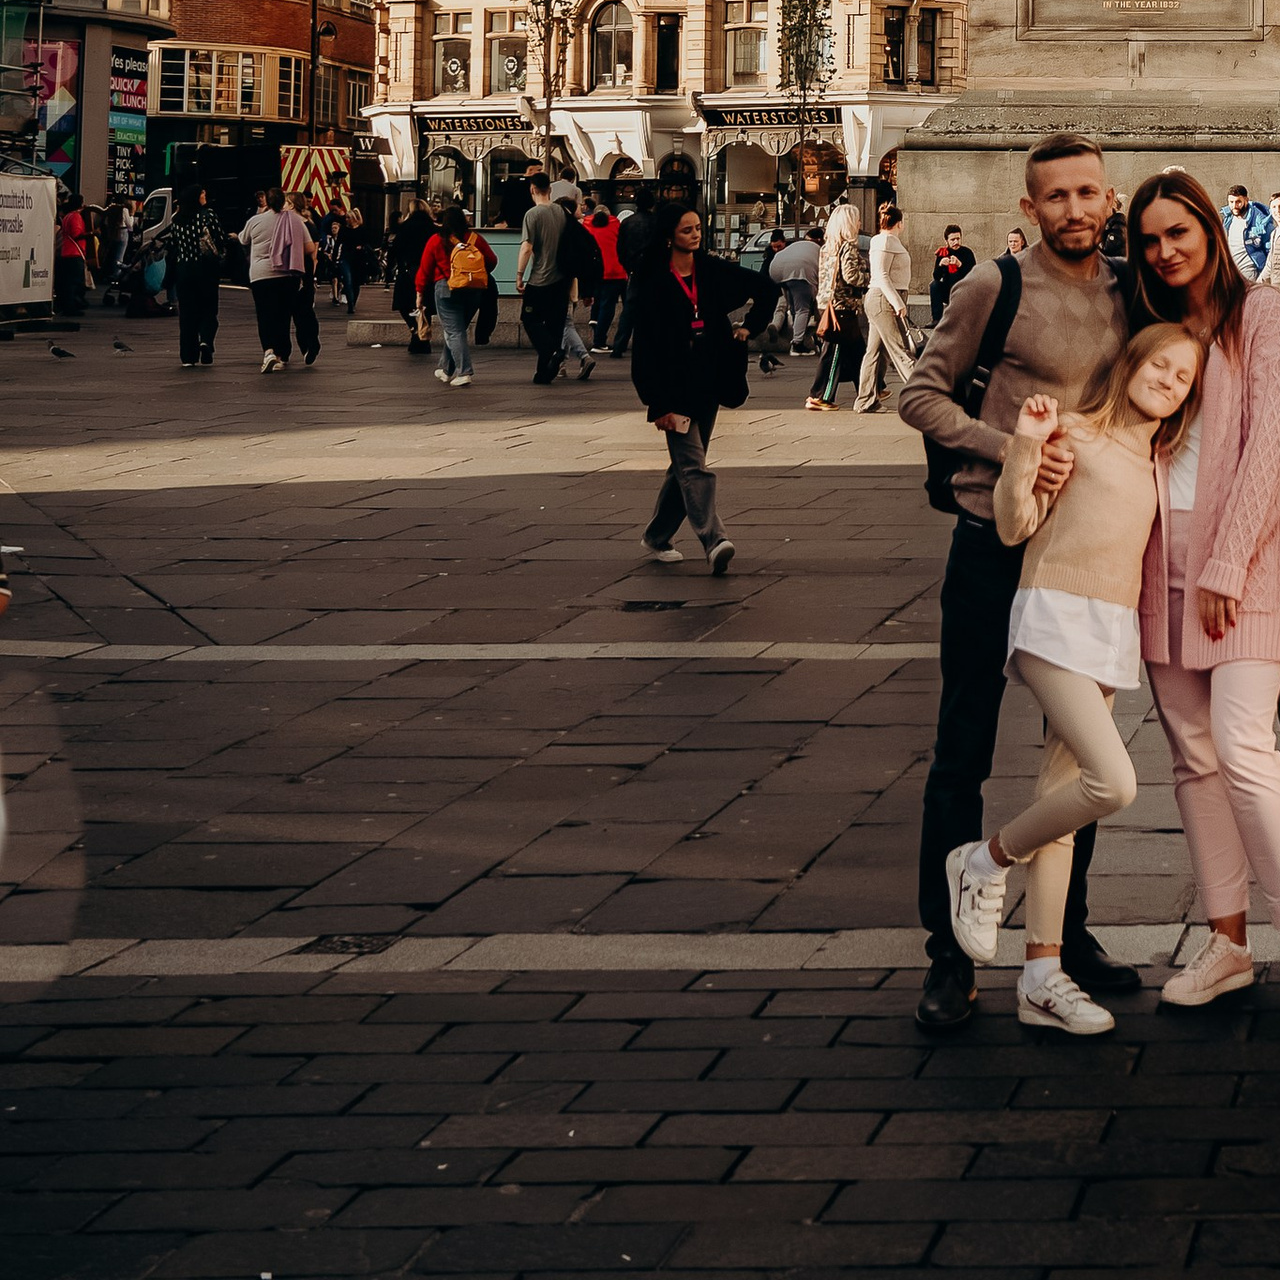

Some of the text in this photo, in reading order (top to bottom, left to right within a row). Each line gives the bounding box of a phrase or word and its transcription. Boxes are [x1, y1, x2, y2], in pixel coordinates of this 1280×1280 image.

[111, 54, 124, 69] Yes
[110, 77, 134, 92] QUICK
[122, 94, 147, 109] LUNCH
[427, 118, 522, 131] WATERSTONES
[722, 111, 829, 125] WATERSTONES
[116, 145, 132, 157] TINY
[359, 138, 375, 150] W
[114, 183, 129, 194] UPS
[26, 193, 33, 209] to
